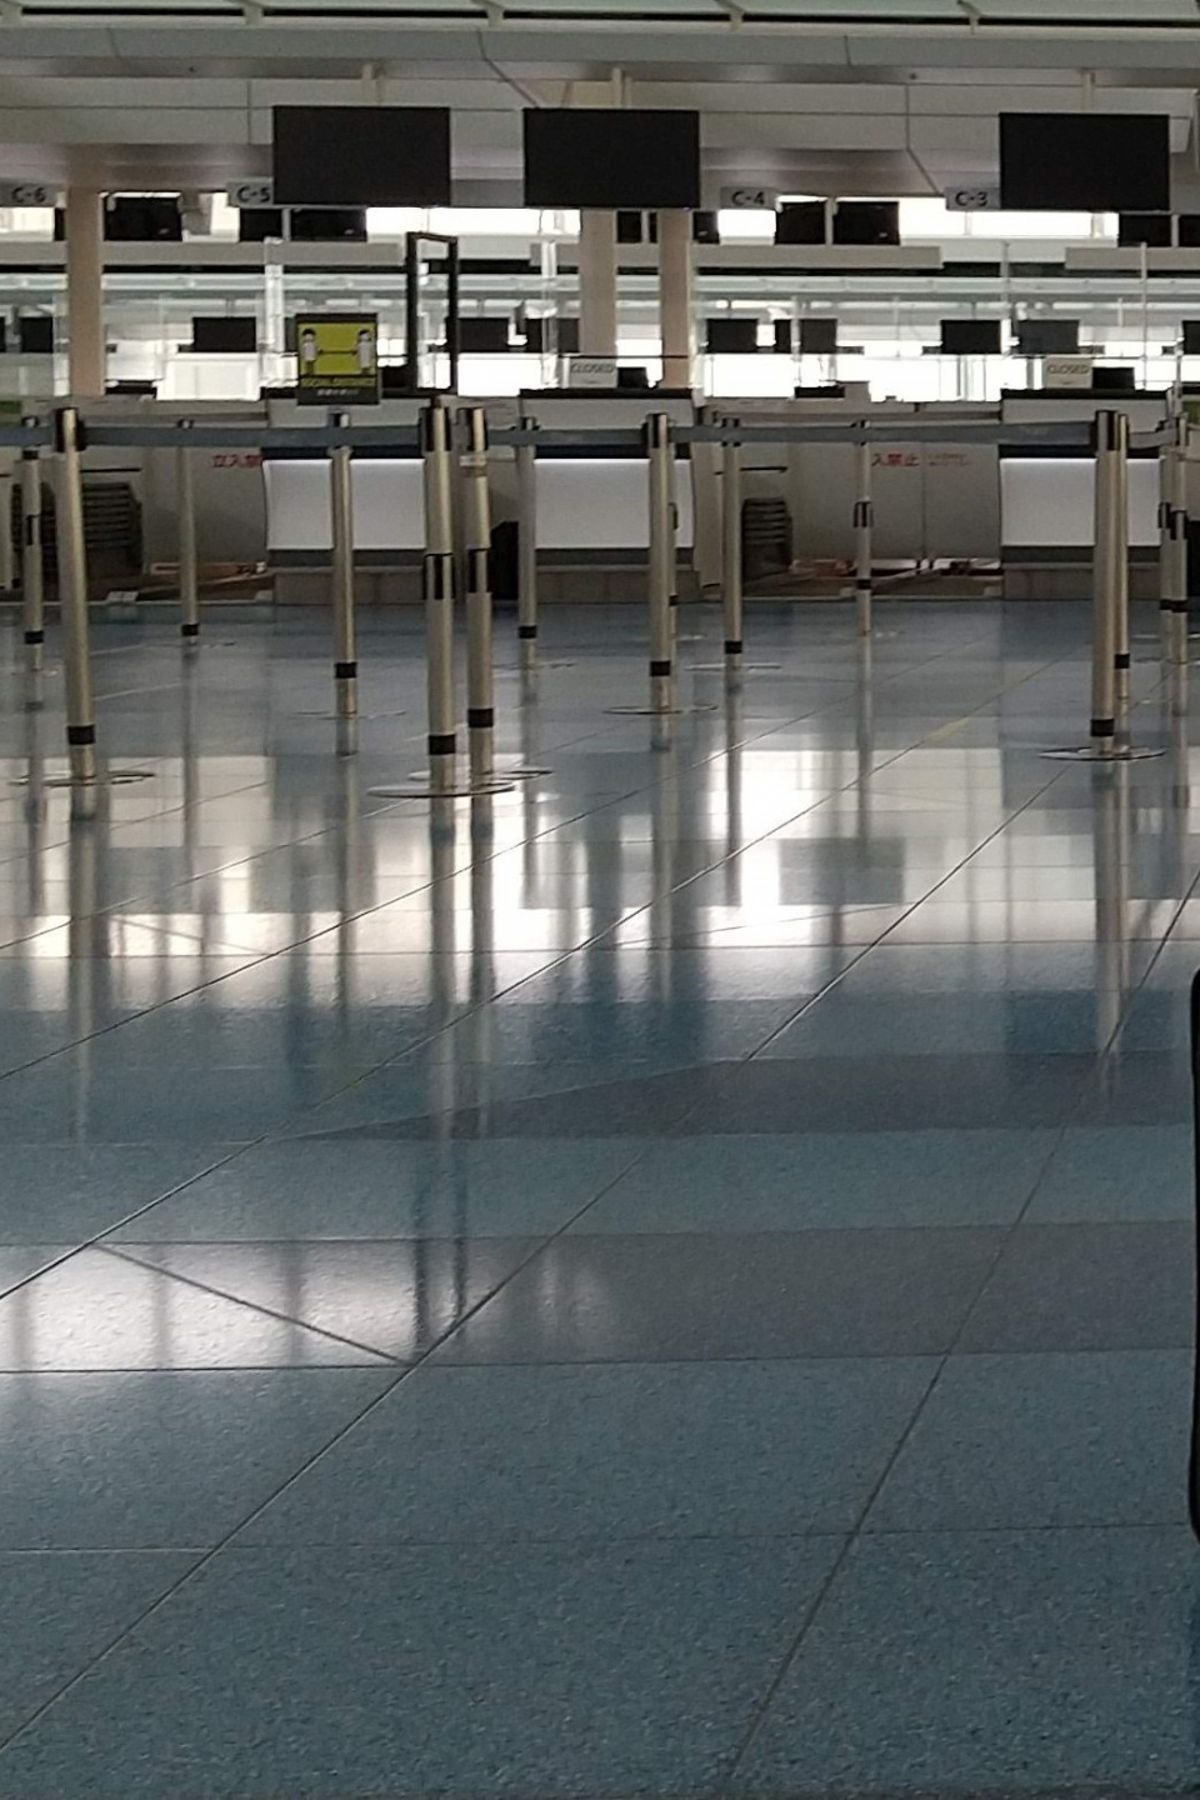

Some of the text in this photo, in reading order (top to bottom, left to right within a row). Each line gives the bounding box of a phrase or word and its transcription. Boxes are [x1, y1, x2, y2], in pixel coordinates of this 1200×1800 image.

[11, 186, 47, 203] C-6
[237, 186, 271, 202] C-5
[731, 190, 765, 206] C-4
[955, 191, 988, 206] C-3
